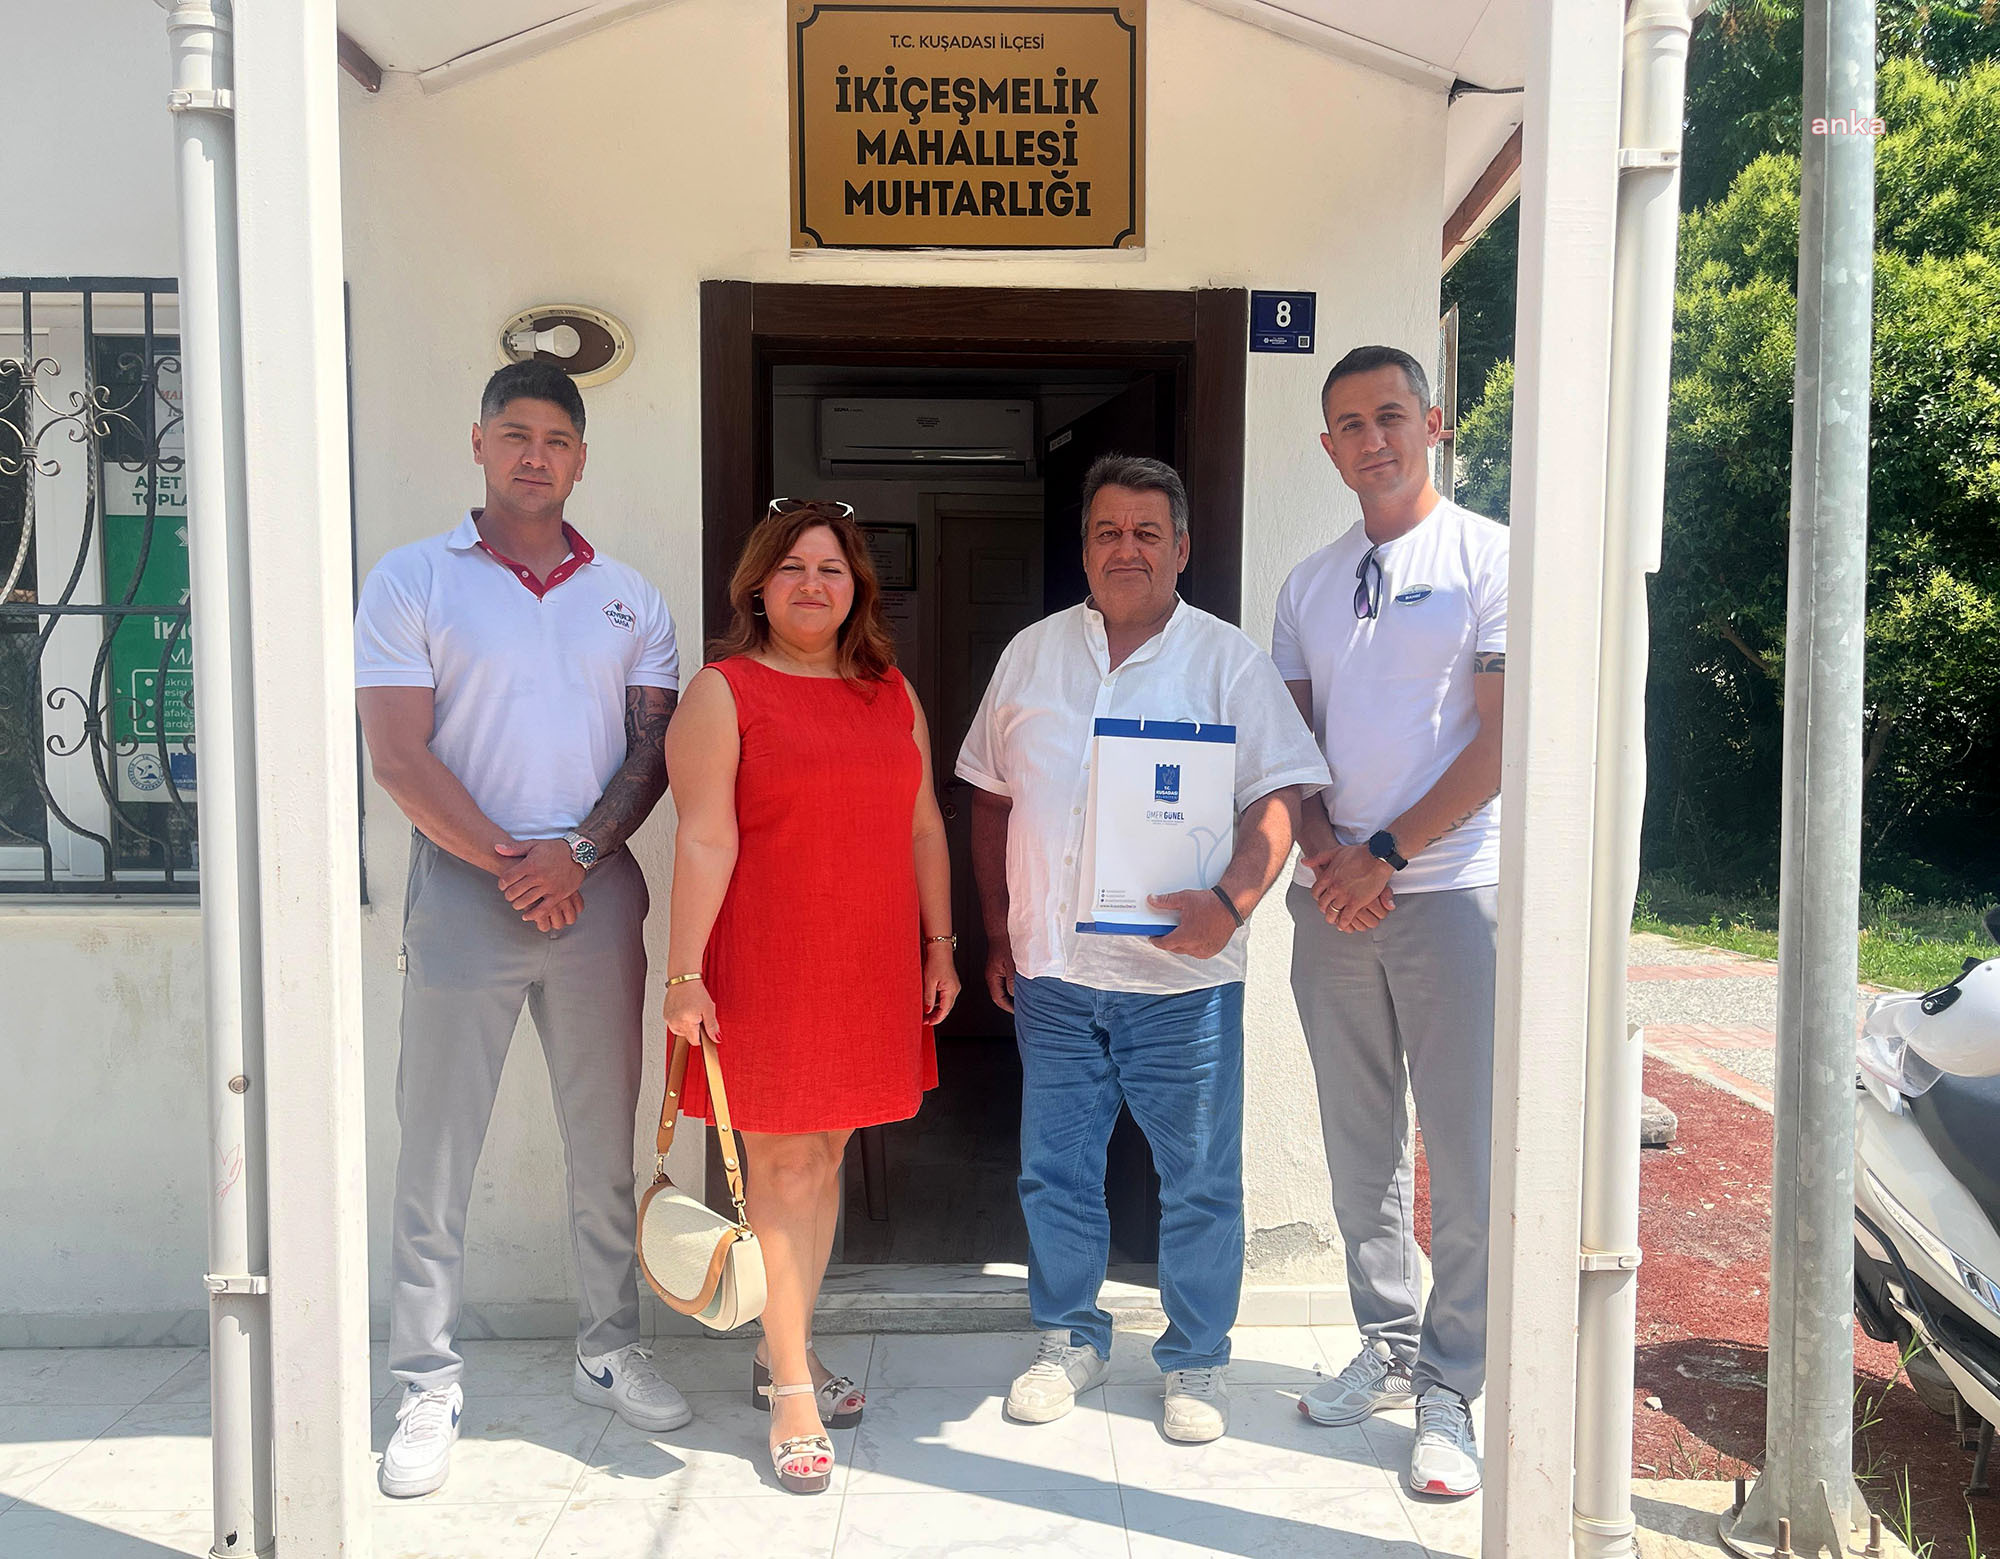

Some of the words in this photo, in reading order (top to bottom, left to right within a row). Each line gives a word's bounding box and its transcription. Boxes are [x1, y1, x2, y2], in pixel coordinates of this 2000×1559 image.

[890, 34, 915, 48] T.C.
[919, 35, 996, 52] KUŞADASI
[1000, 33, 1045, 52] İLÇESİ
[835, 64, 1099, 125] İKİÇEŞMELİK
[856, 119, 1078, 166] MAHALLESİ
[844, 170, 1091, 216] MUHTARLIĞI
[1276, 300, 1291, 327] 8
[135, 475, 182, 489] AET
